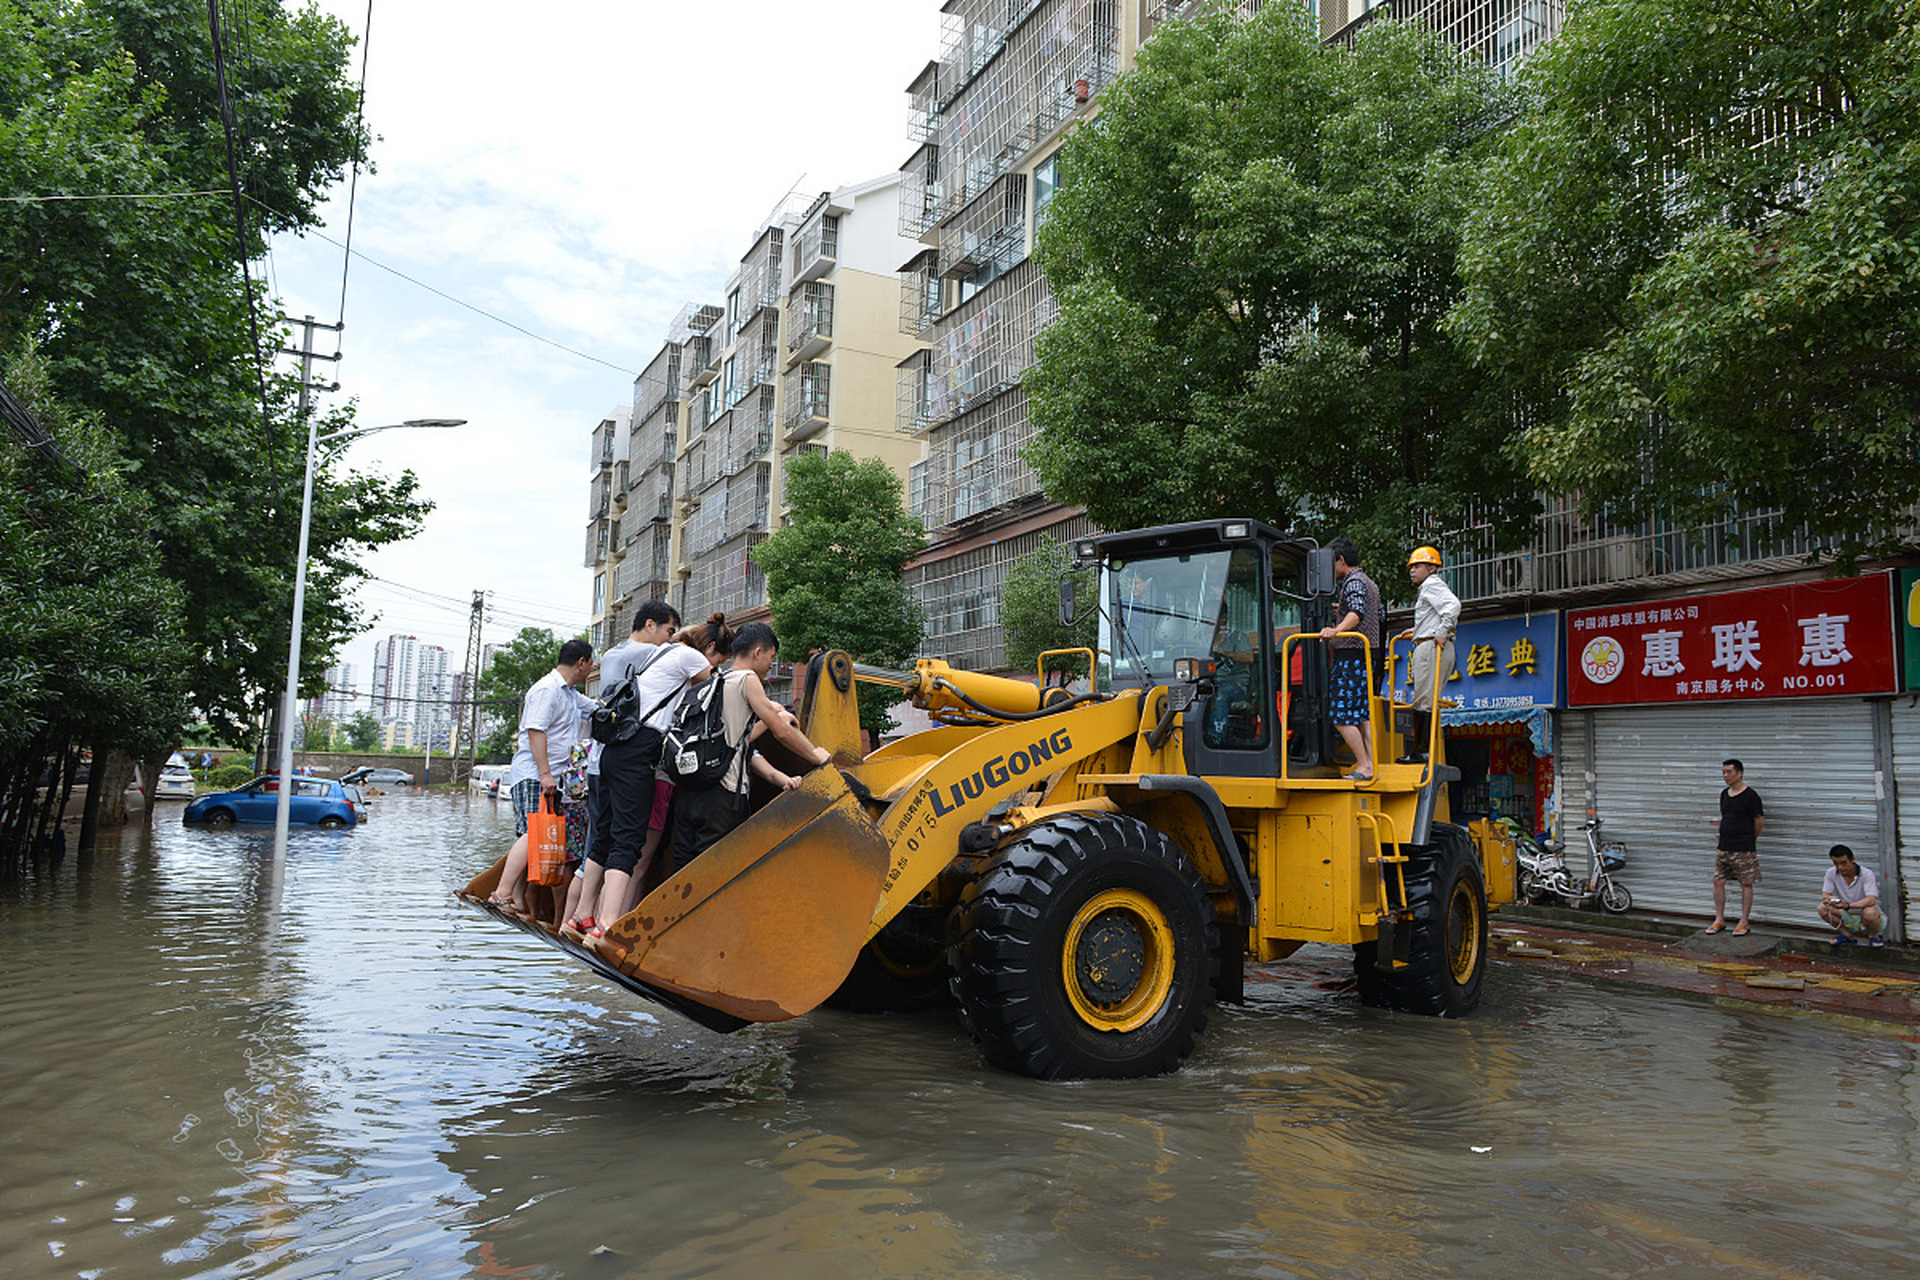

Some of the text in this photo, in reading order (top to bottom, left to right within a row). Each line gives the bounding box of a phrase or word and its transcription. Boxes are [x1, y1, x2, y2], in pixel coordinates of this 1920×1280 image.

[1574, 606, 1699, 631] 中国消费联盟有限公司
[1641, 613, 1853, 677] 惠联惠
[1676, 673, 1845, 695] 南京服务中心 NO.001
[906, 811, 938, 852] 075
